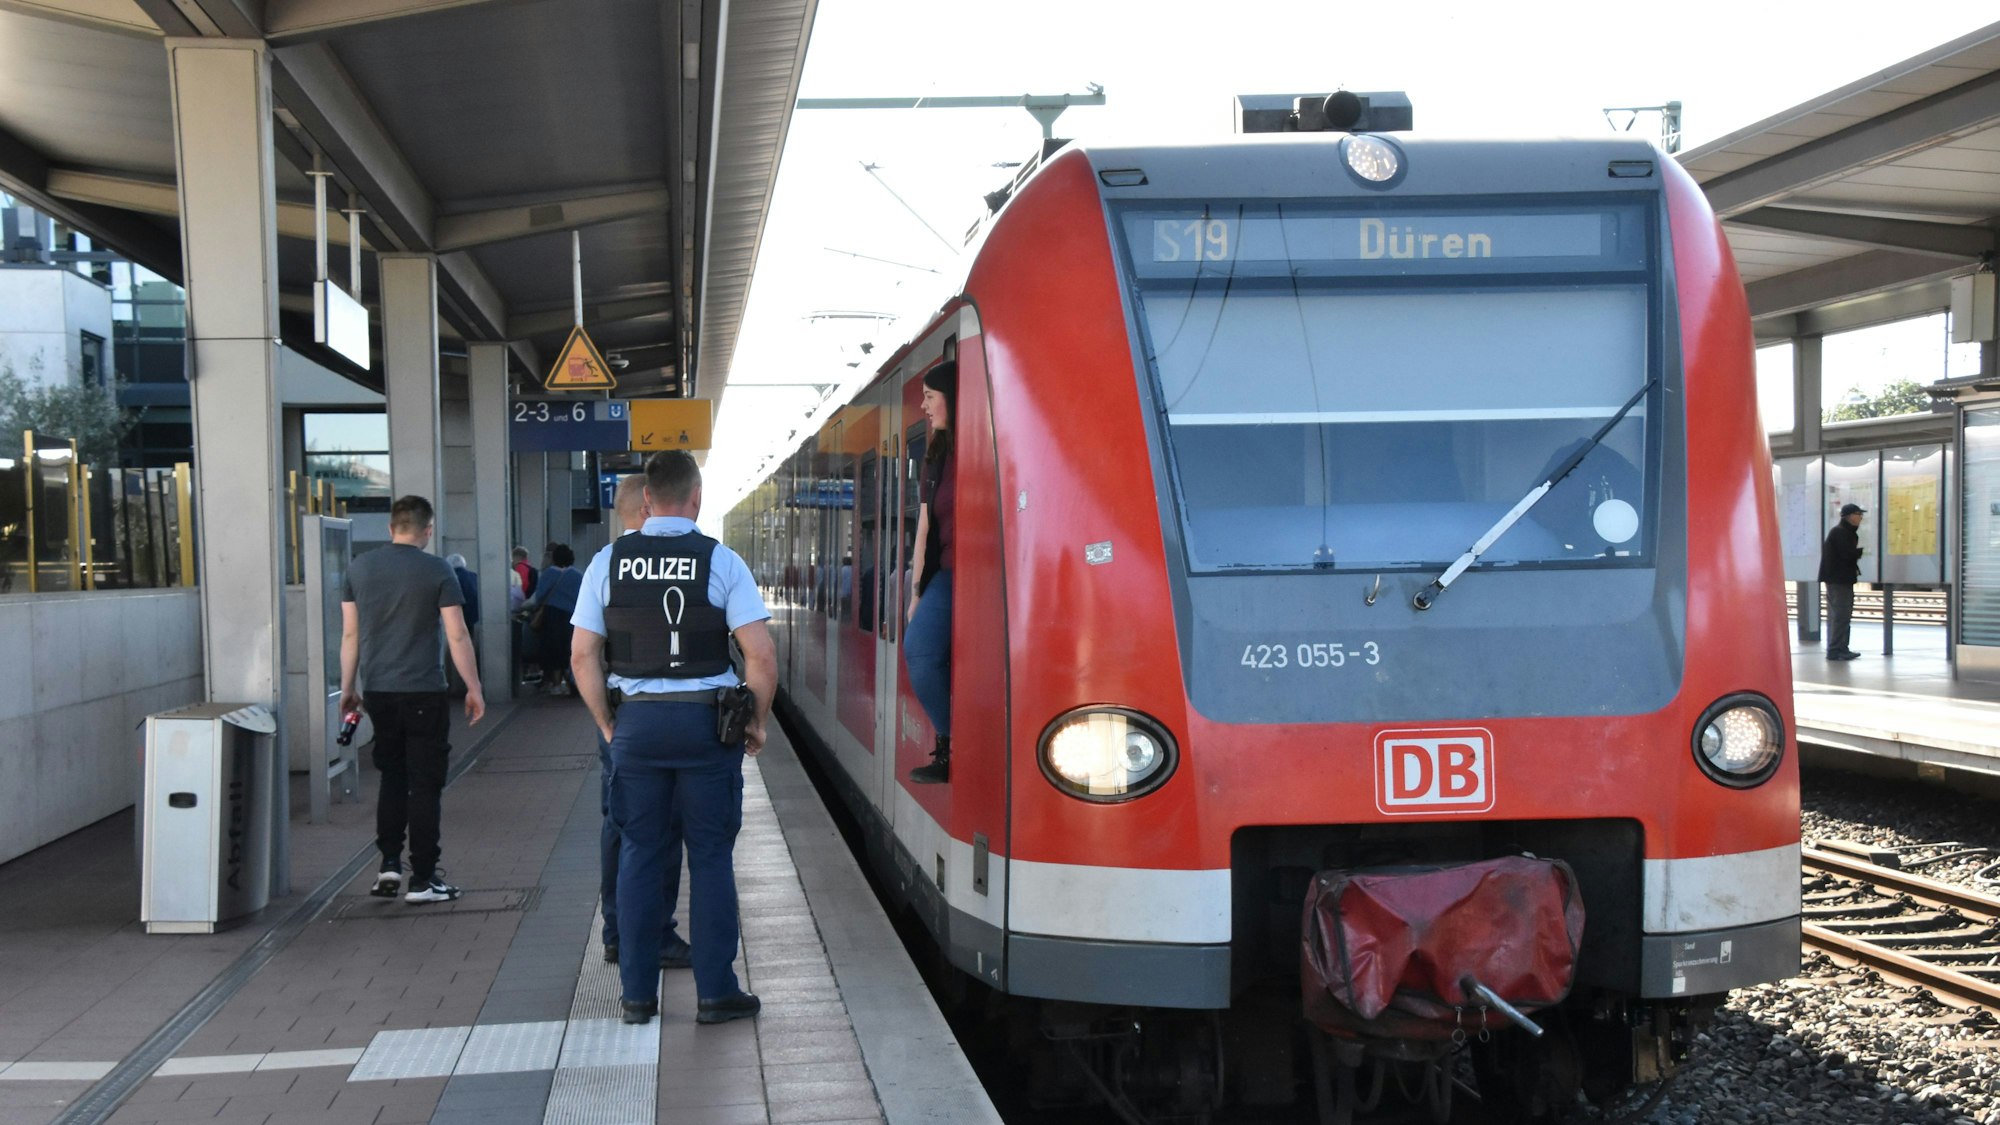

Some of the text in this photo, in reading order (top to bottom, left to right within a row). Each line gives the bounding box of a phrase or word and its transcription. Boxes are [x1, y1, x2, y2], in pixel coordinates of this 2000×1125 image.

[1156, 219, 1228, 262] S19
[1359, 217, 1492, 260] Düren
[514, 402, 586, 422] 2-3 und 6
[618, 557, 697, 580] POLIZEI
[1240, 641, 1380, 669] 423 055-3
[1391, 743, 1480, 800] DB
[226, 780, 242, 891] Abfall
